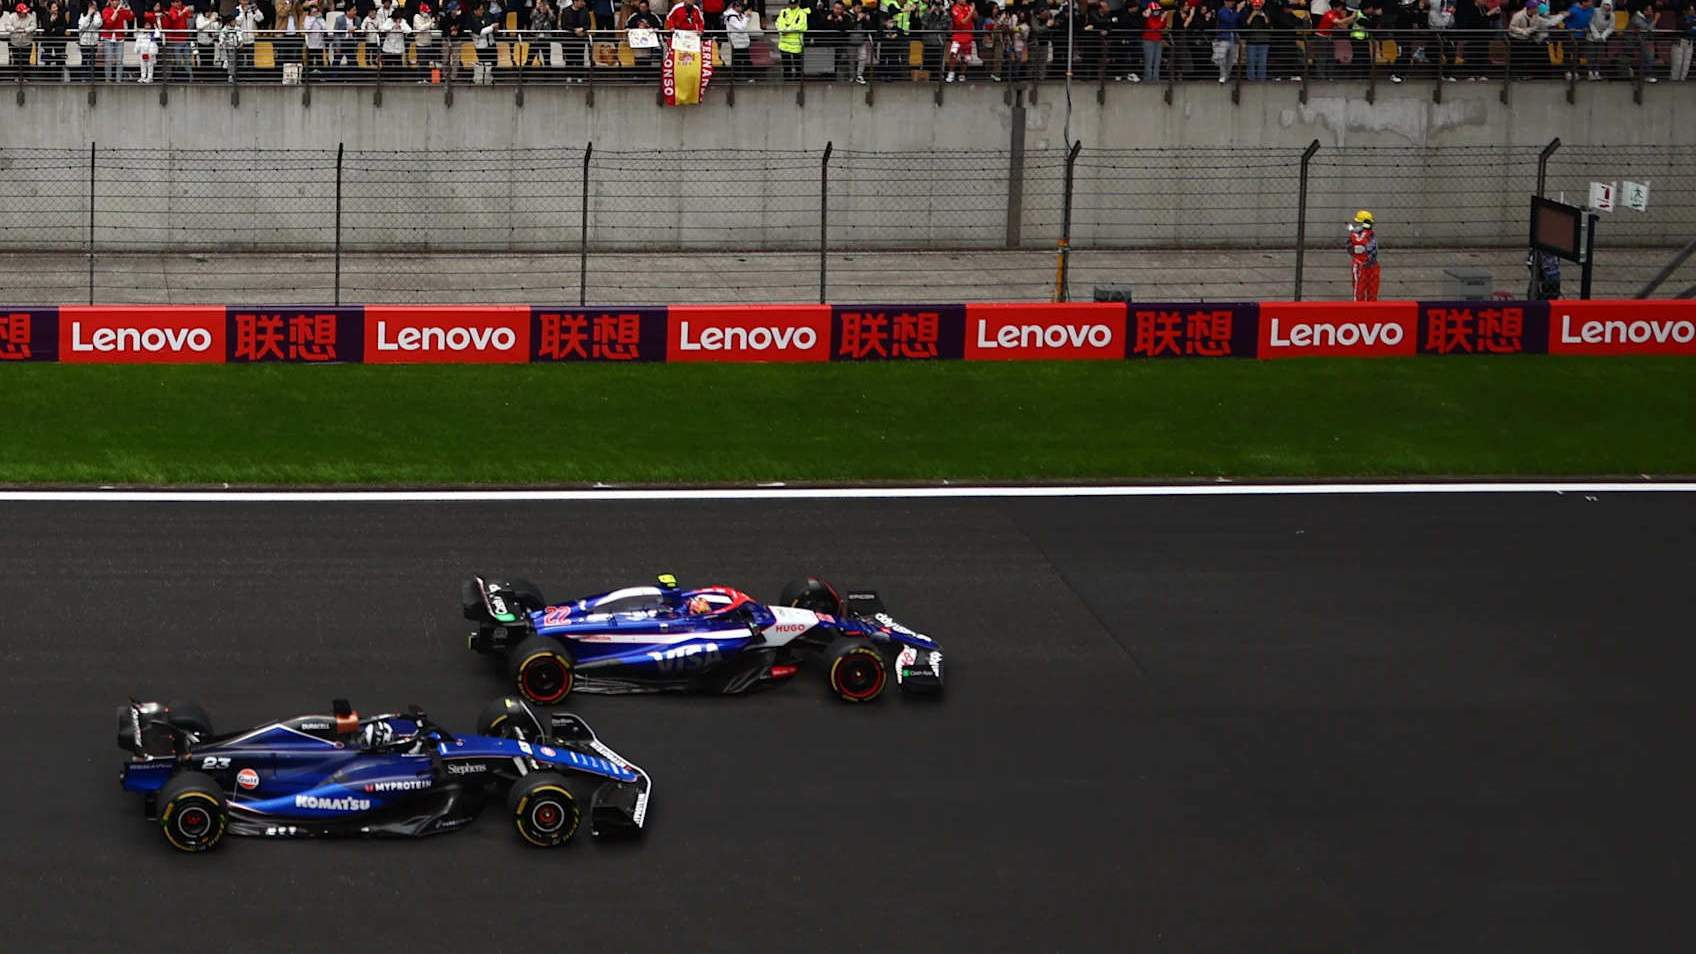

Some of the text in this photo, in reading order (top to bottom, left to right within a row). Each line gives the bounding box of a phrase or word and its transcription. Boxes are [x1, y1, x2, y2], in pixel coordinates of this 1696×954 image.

[73, 314, 336, 360] Lenovo 联想
[378, 314, 640, 359] Lenovo 联想
[681, 313, 940, 359] Lenovo 联想
[978, 312, 1232, 356] Lenovo 联想
[1271, 309, 1522, 353] Lenovo 联想
[1562, 316, 1696, 342] Lenovo
[543, 606, 572, 626] 22
[775, 624, 805, 633] HUGO
[647, 642, 723, 672] VISA
[201, 756, 232, 770] 23
[447, 762, 486, 775] Stephens
[238, 775, 258, 784] Gulf
[374, 780, 432, 792] MYPROTEIN
[295, 794, 371, 811] KOMATSU
